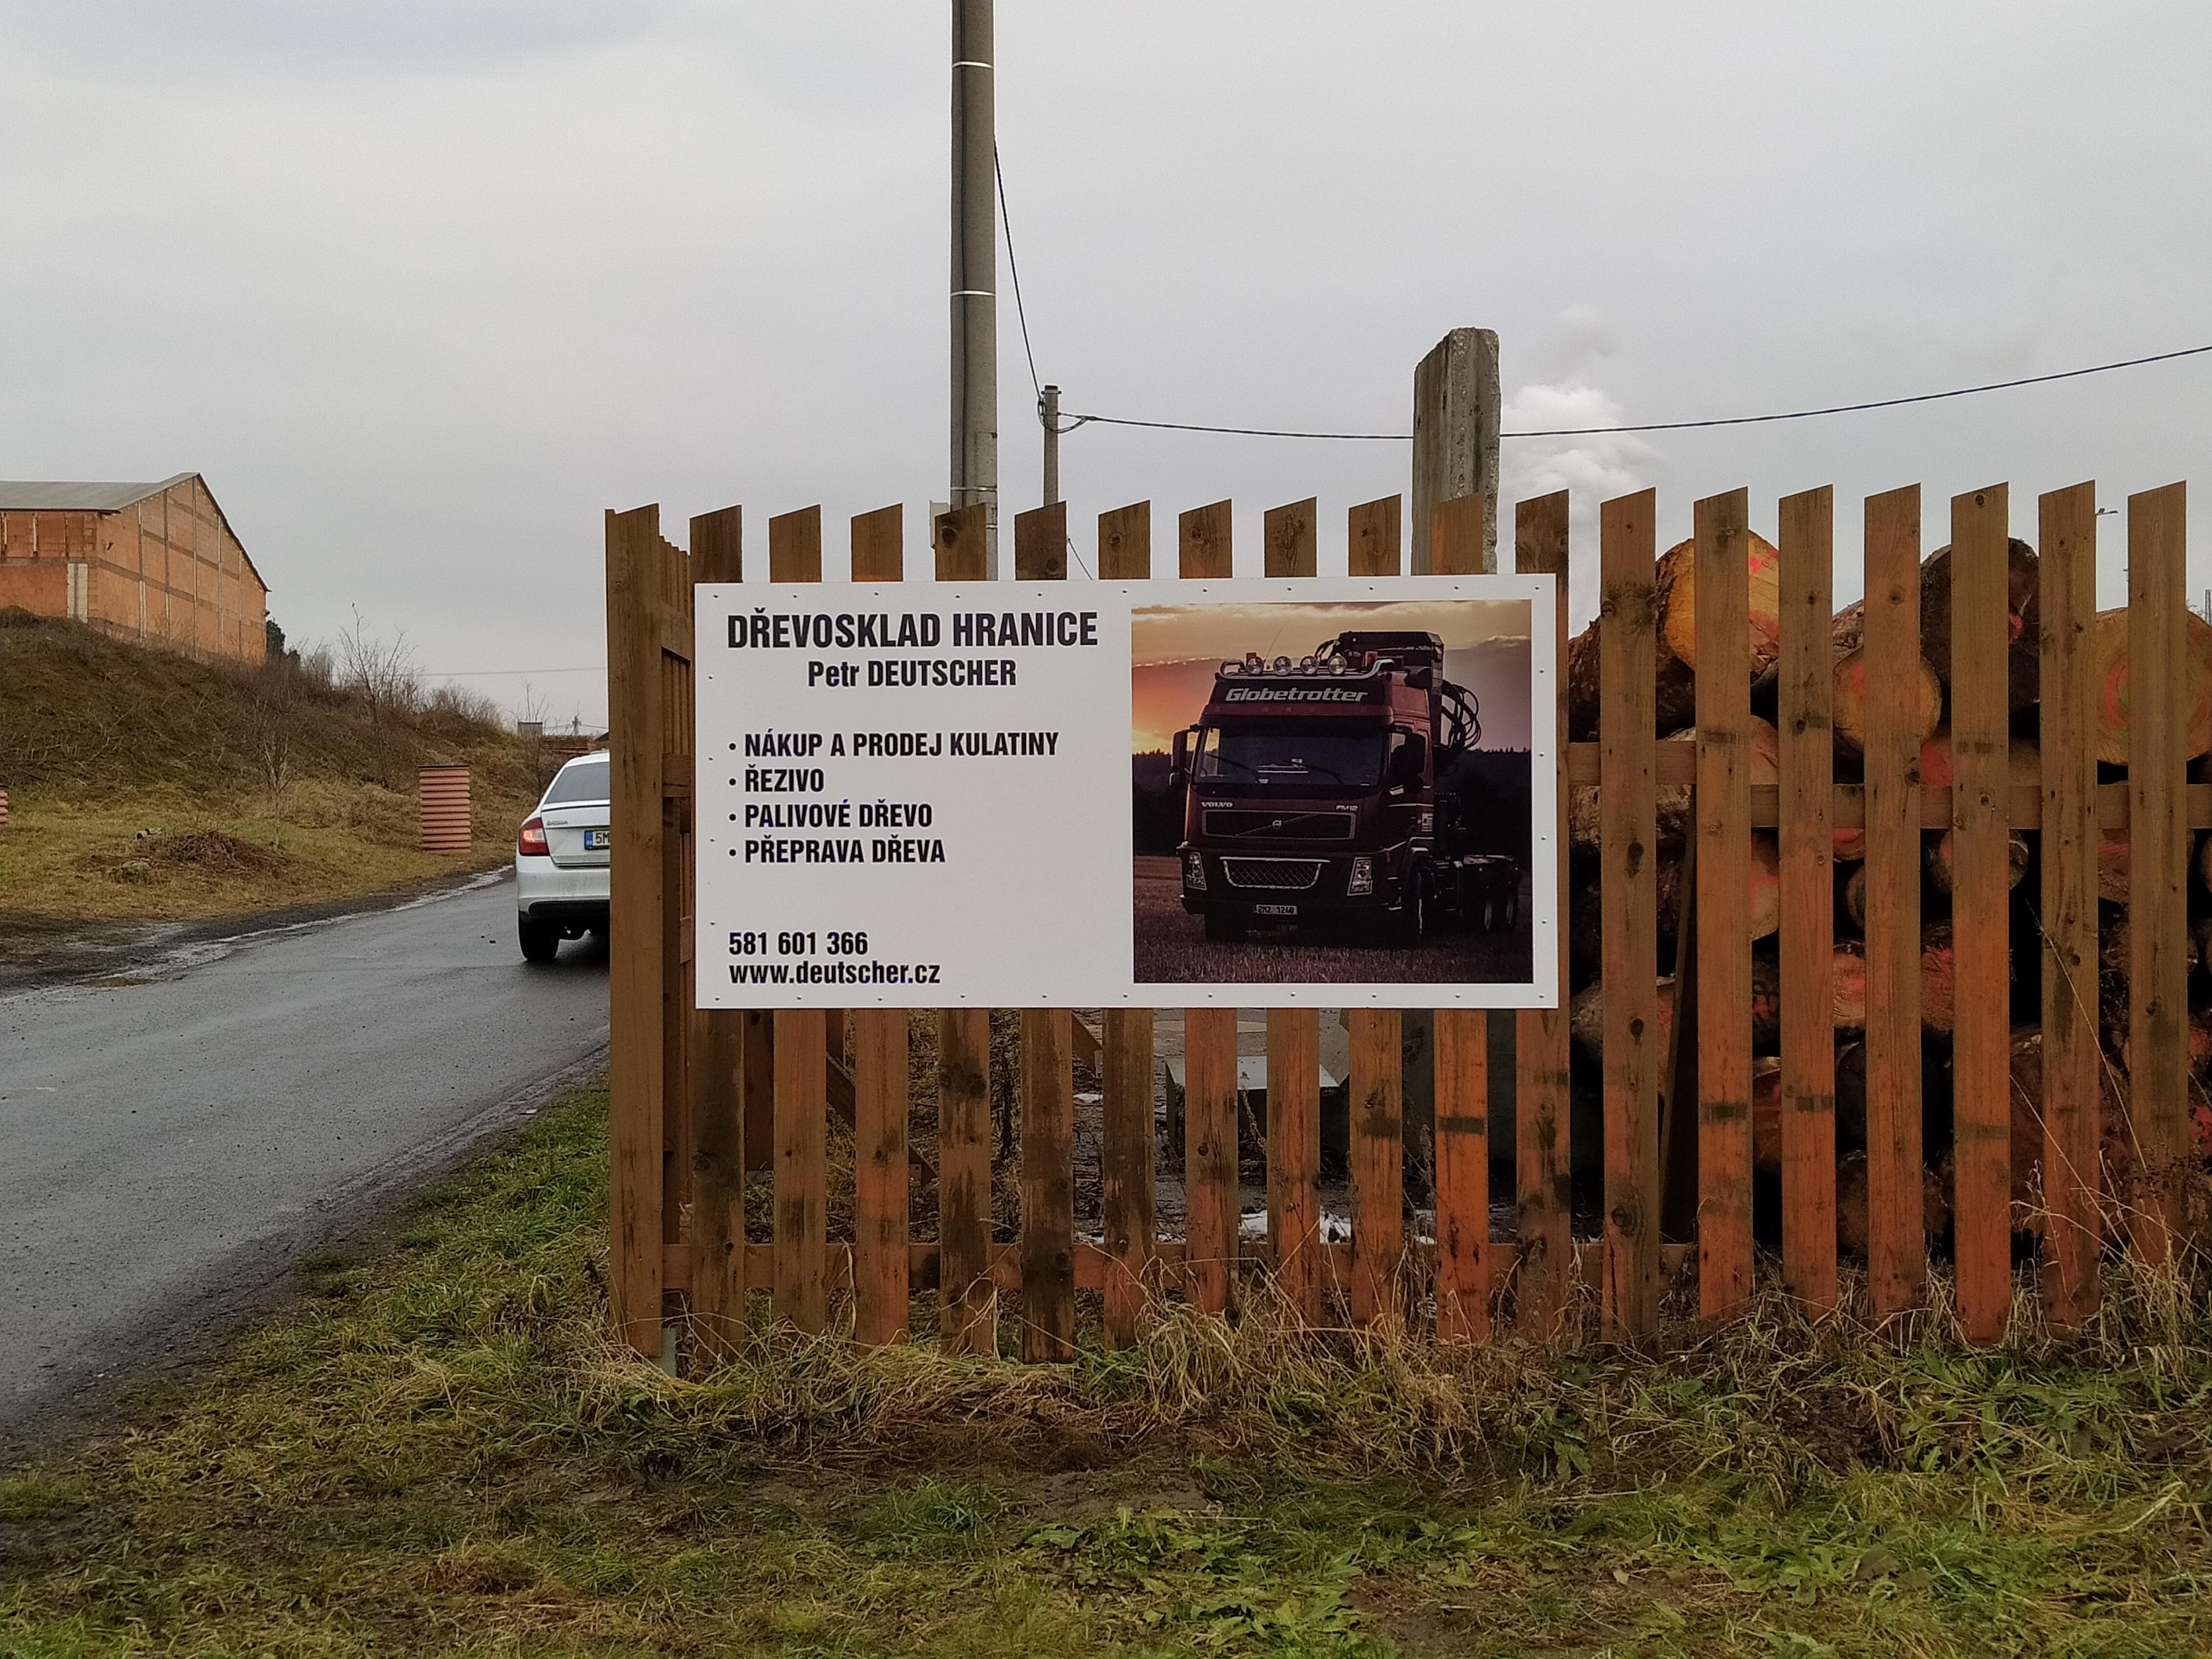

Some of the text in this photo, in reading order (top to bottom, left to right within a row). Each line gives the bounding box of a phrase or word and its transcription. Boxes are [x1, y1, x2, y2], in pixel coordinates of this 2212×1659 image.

[728, 608, 1098, 648] DŘEVOSKLAD HRANICE
[808, 659, 1016, 687] Petr DEUTSCHER
[1225, 687, 1368, 702] Globetrotter
[745, 728, 1059, 757] NÁKUP A PRODEJ KULATINY
[745, 764, 824, 792] ŘEZIVO
[745, 799, 932, 828] PALIVOVÉ DŘEVO
[596, 832, 611, 844] 5M
[745, 834, 946, 863] PŘEPRAVA DŘEVA
[729, 931, 868, 955] 581 601 366
[729, 960, 940, 984] www.deutscher.cz
